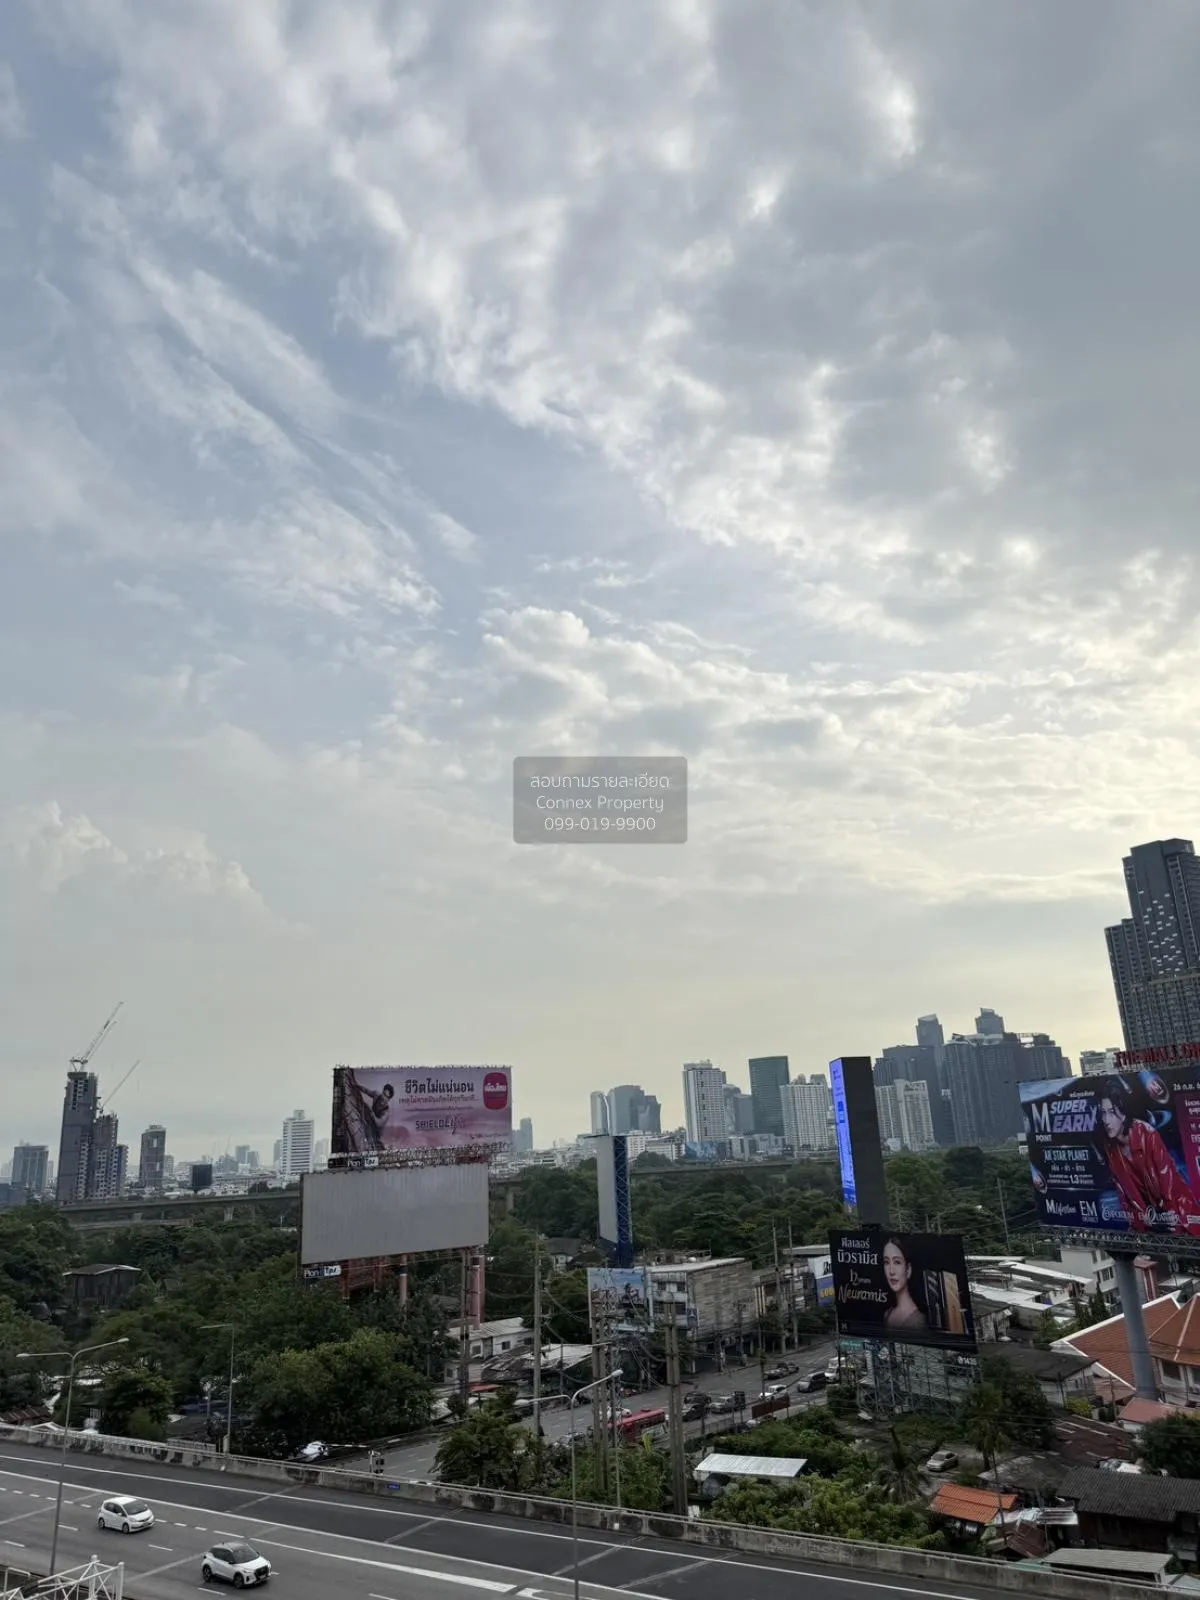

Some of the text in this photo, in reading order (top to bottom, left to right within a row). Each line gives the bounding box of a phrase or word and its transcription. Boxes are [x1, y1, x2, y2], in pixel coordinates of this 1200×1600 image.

[405, 1078, 474, 1094] ชีวิตไม่แน่นอน
[1031, 1099, 1087, 1133] M SUPER
[1052, 1113, 1097, 1133] EARN
[1035, 1134, 1052, 1142] POINT
[1053, 1150, 1067, 1161] STAR
[1068, 1150, 1089, 1161] PLANET
[1080, 1200, 1098, 1217] EM
[837, 1249, 879, 1265] นิวรามิส
[838, 1283, 889, 1304] Neuramis
